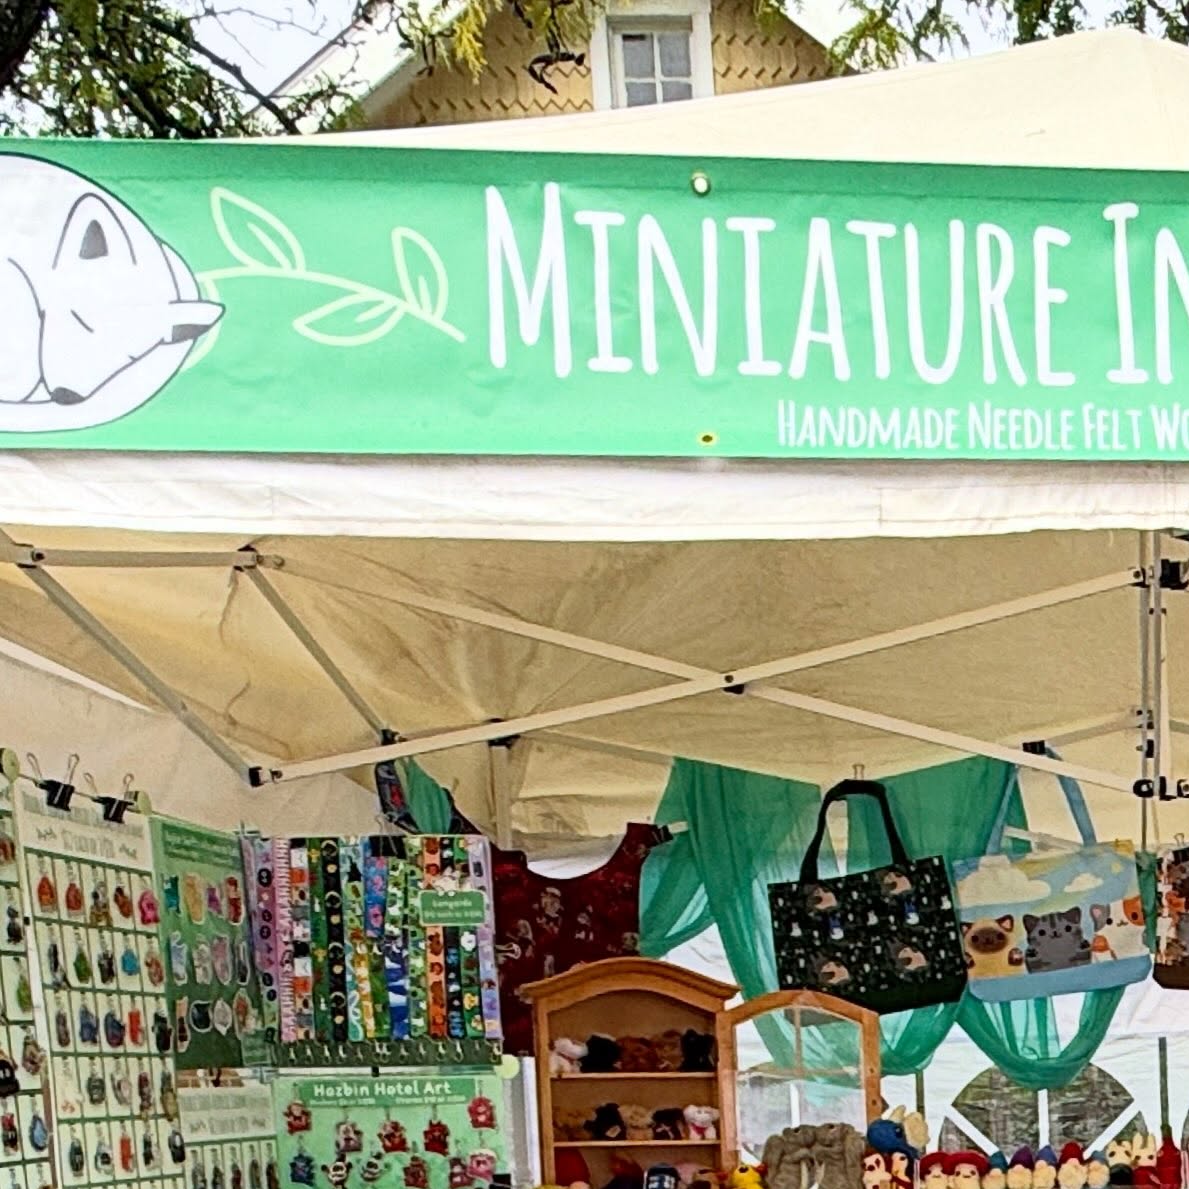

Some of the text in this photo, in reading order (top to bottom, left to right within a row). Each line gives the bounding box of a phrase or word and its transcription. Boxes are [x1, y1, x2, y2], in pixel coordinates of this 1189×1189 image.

[485, 182, 1075, 386] MINIATURE
[777, 399, 960, 449] HANDMADE
[967, 400, 1074, 450] NEEDLE
[1081, 402, 1143, 451] FELT
[314, 1079, 452, 1097] Hazbin Hotel Art
